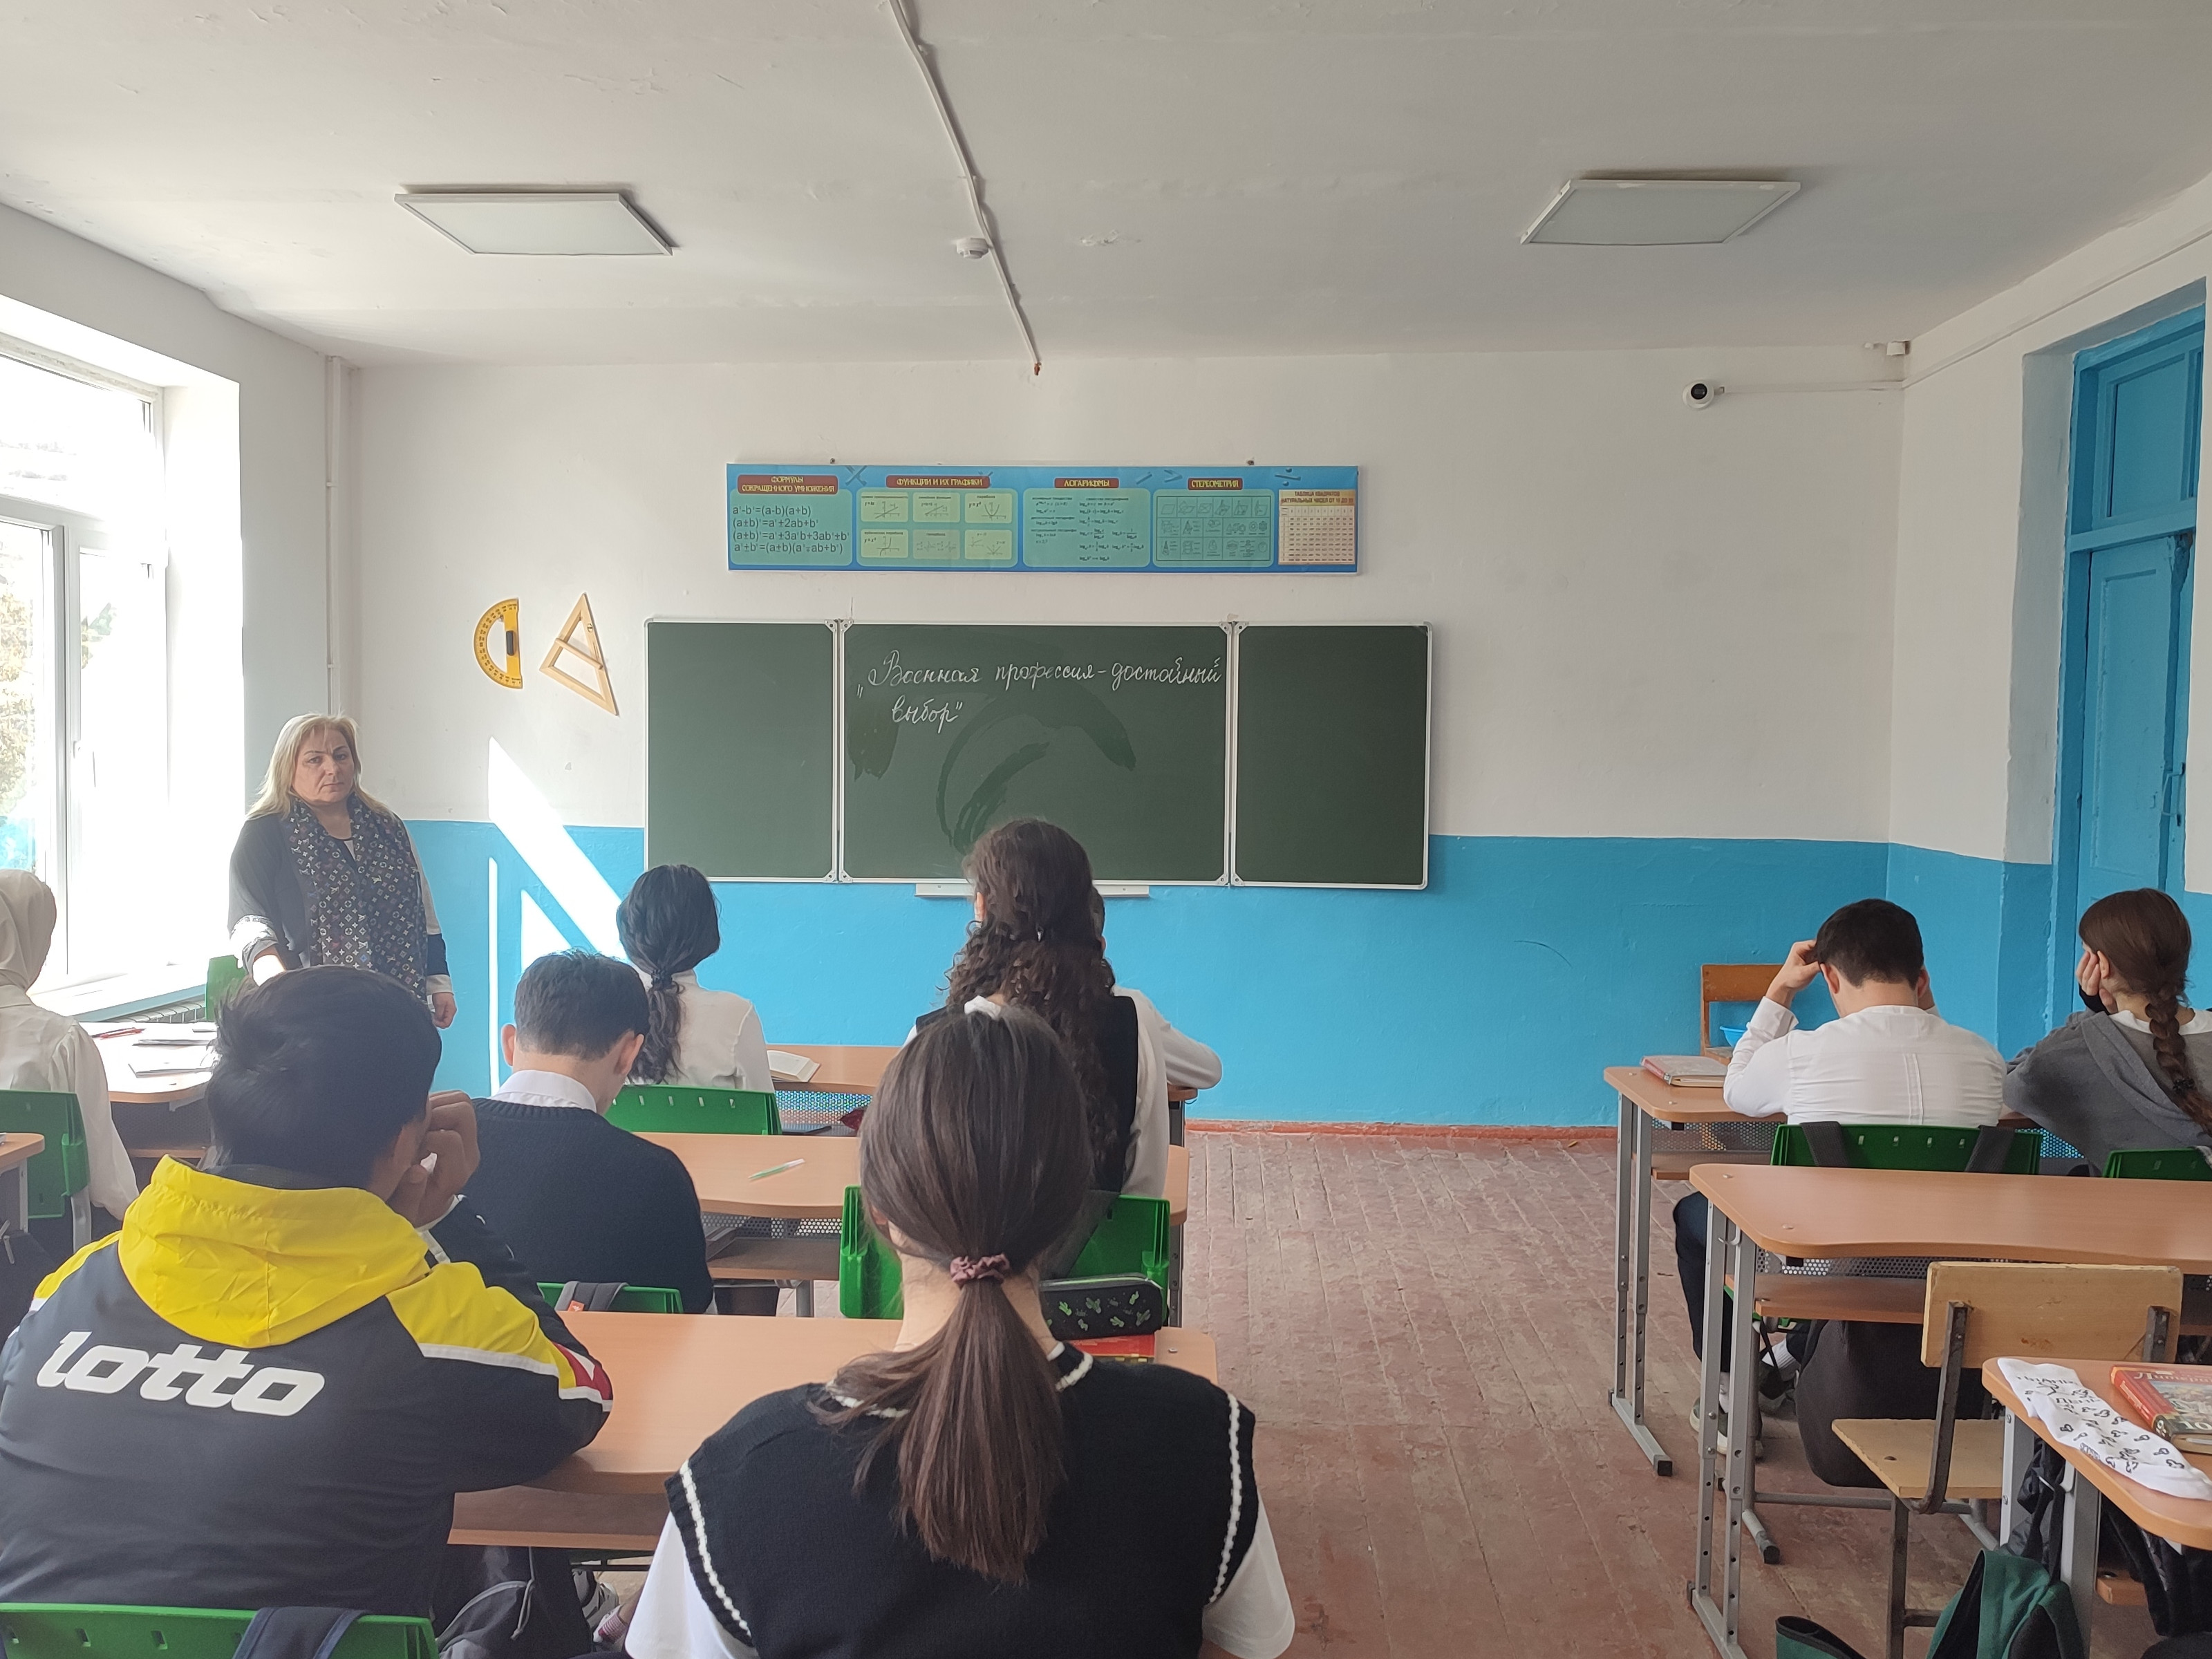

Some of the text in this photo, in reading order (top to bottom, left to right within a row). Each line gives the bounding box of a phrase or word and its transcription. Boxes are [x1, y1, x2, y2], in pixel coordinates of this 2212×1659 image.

[896, 478, 932, 487] ФУНКЦИИ
[1191, 480, 1239, 488] СТЕРЕОМЕТРИЯ
[37, 1330, 326, 1417] lotto
